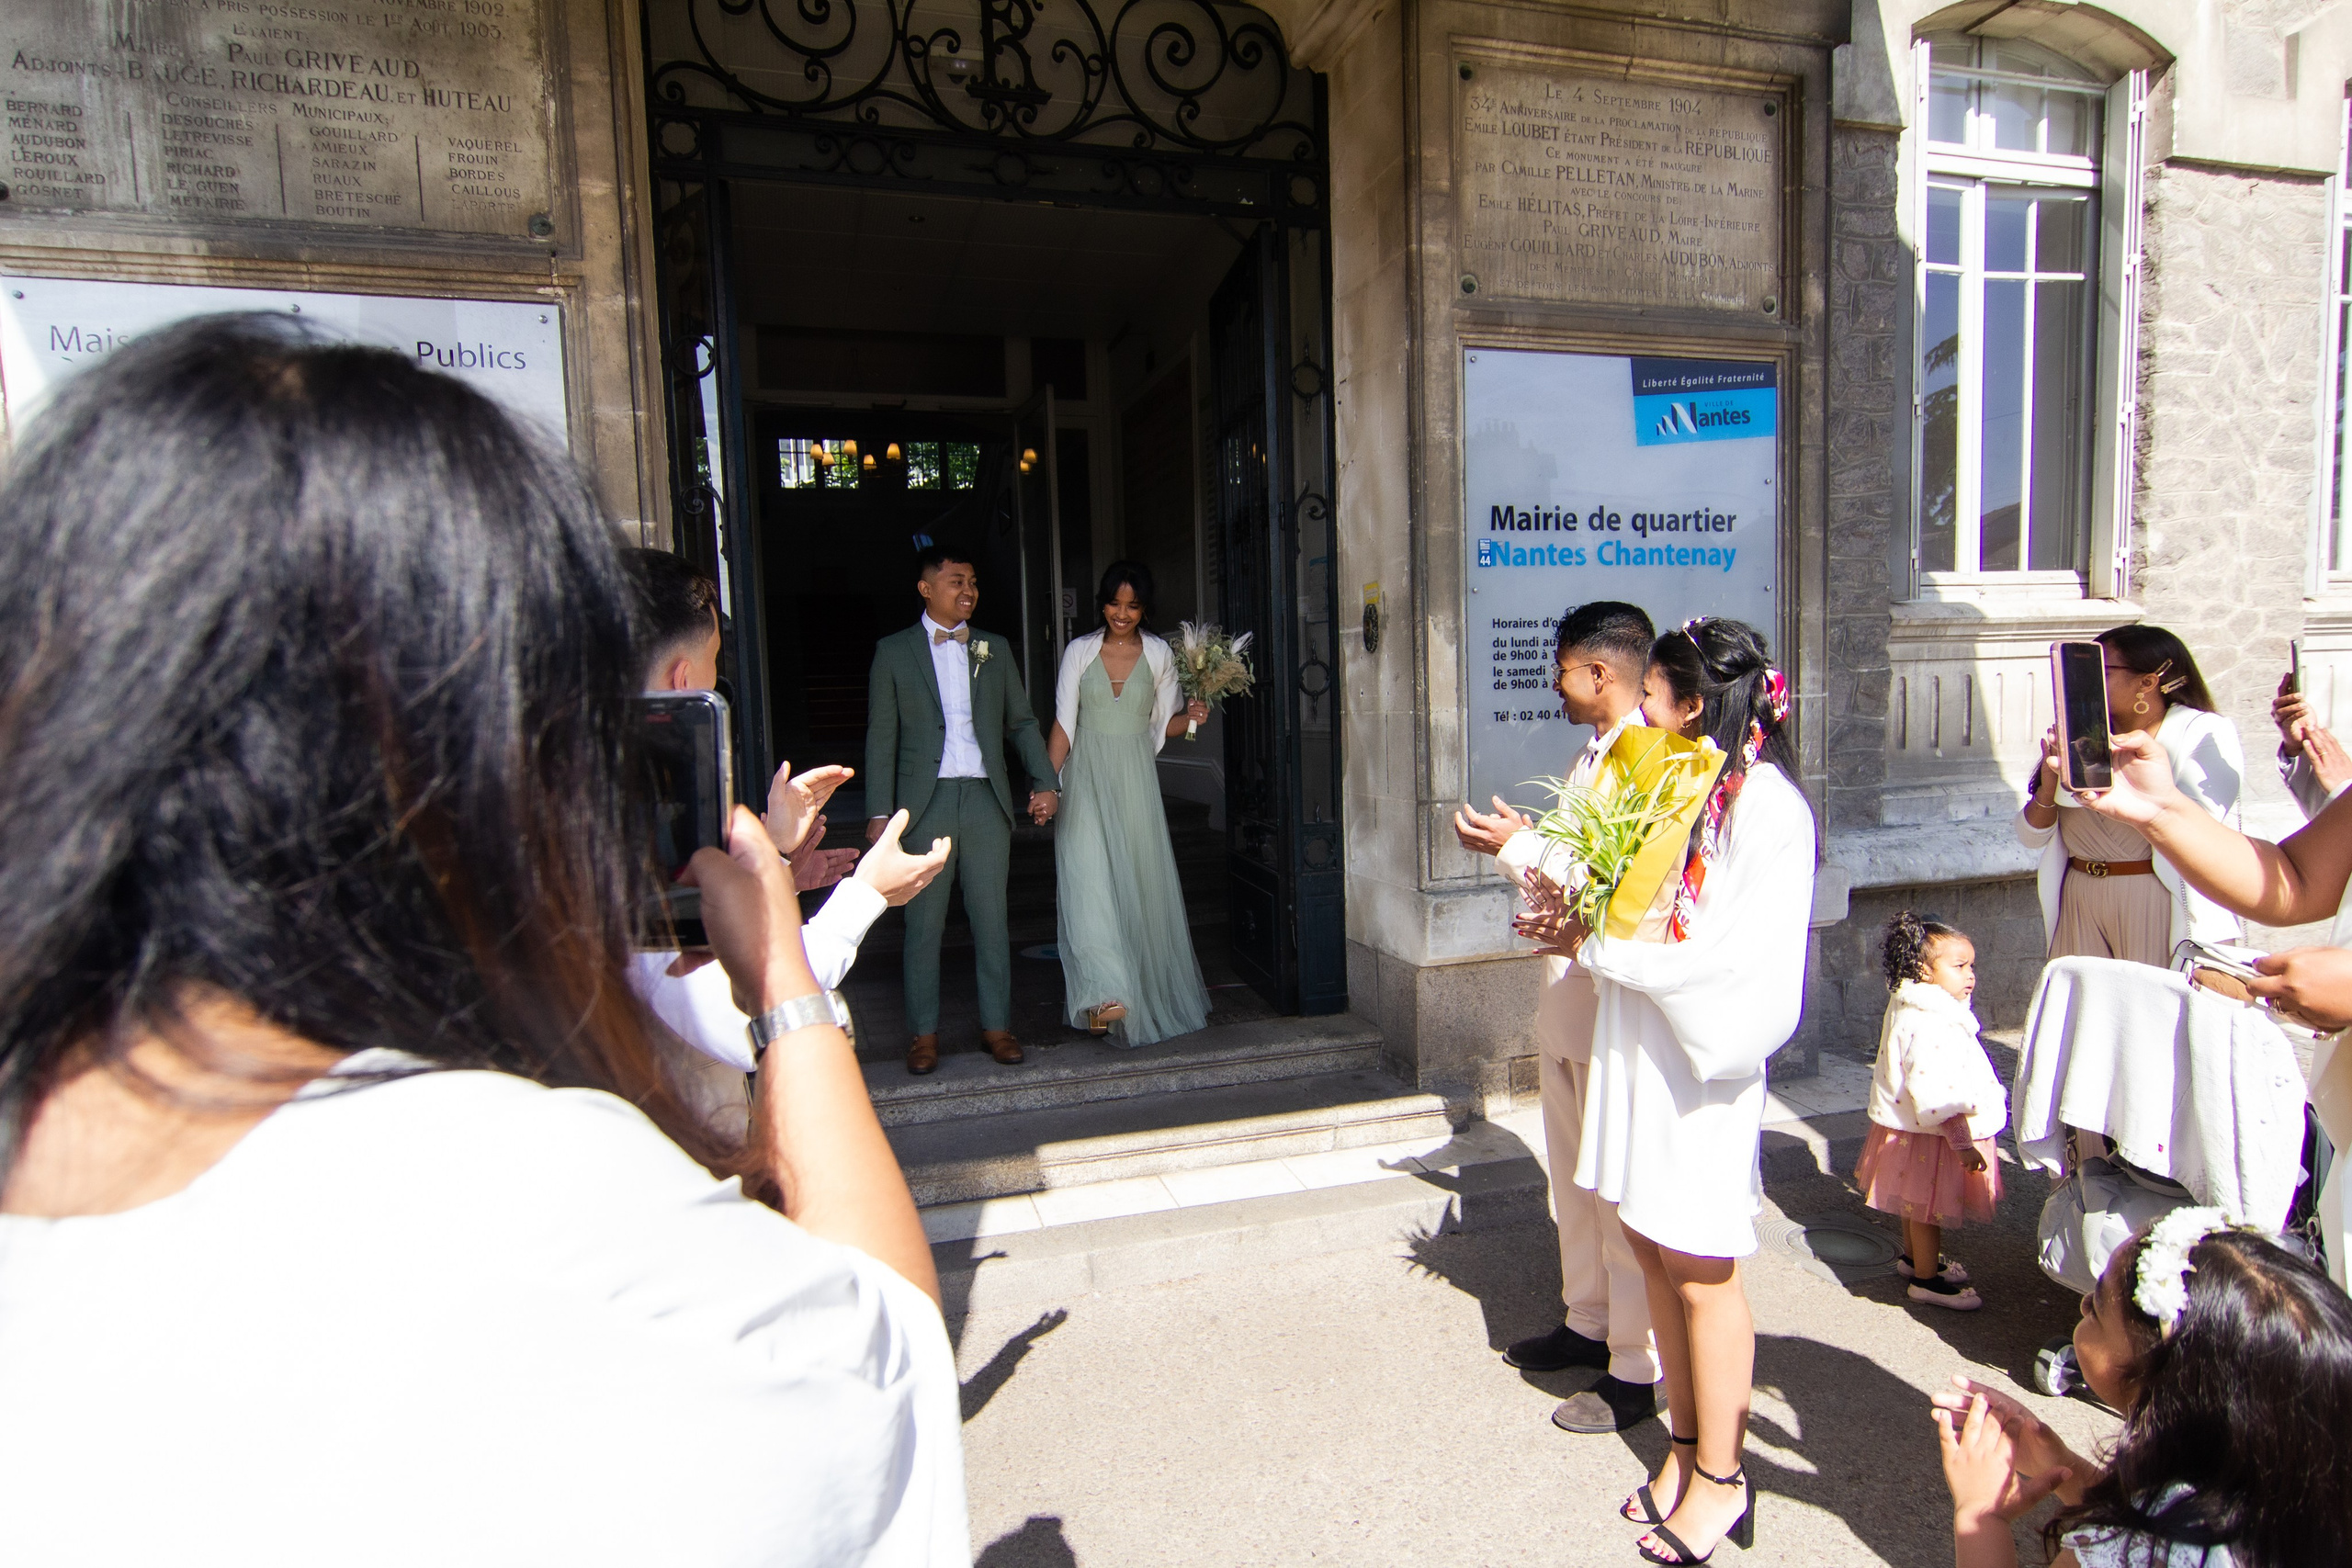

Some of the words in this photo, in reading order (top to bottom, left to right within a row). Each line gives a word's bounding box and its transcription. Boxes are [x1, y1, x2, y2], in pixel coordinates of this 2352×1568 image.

[259, 4, 348, 23] POSSESSION
[227, 42, 275, 66] PAUL
[165, 91, 277, 115] CONSEILLERS
[397, 91, 417, 105] ET
[424, 87, 511, 112] HUTEAU
[6, 100, 83, 117] BERNARD
[162, 113, 254, 130] DESOUCHES
[12, 134, 86, 149] AUDUBON
[310, 126, 398, 142] GOUILLARD
[311, 142, 368, 155] AMIEUX
[447, 137, 522, 153] VAQUEREL
[164, 146, 214, 160] PIRIAC
[448, 152, 499, 165] FROUIN
[167, 162, 236, 178] RICHARD
[312, 157, 377, 172] SARAZIN
[14, 167, 106, 185] ROUILLARD
[313, 174, 362, 187] RUAUX
[449, 167, 505, 182] BORDES
[17, 185, 84, 198] GOSNET
[451, 184, 521, 199] CAILLOUS
[315, 205, 371, 219] BOUTIN
[416, 341, 526, 369] Publics
[1643, 377, 1677, 389] Liberté
[1680, 375, 1714, 388] Égalité
[1717, 372, 1765, 384] Fraternité
[1491, 505, 1578, 532] Mairie
[1589, 505, 1622, 532] de
[1632, 507, 1736, 538] quartier
[1480, 555, 1491, 566] 44
[1491, 541, 1587, 567] Nantes
[1597, 540, 1737, 573] Chantenay
[1492, 617, 1539, 629] Horaires
[1493, 637, 1507, 648] du
[1511, 637, 1539, 648] lundi
[1543, 638, 1556, 647] au
[1493, 650, 1507, 661] de
[1510, 649, 1538, 660] 9h00
[1542, 649, 1548, 660] à
[1493, 666, 1503, 677] le
[1507, 665, 1545, 676] samedi
[1493, 679, 1507, 690] de
[1511, 679, 1539, 690] 9h00
[1542, 678, 1548, 689] à
[1494, 711, 1510, 722] Tél
[1520, 711, 1533, 721] 02
[1537, 710, 1550, 720] 40
